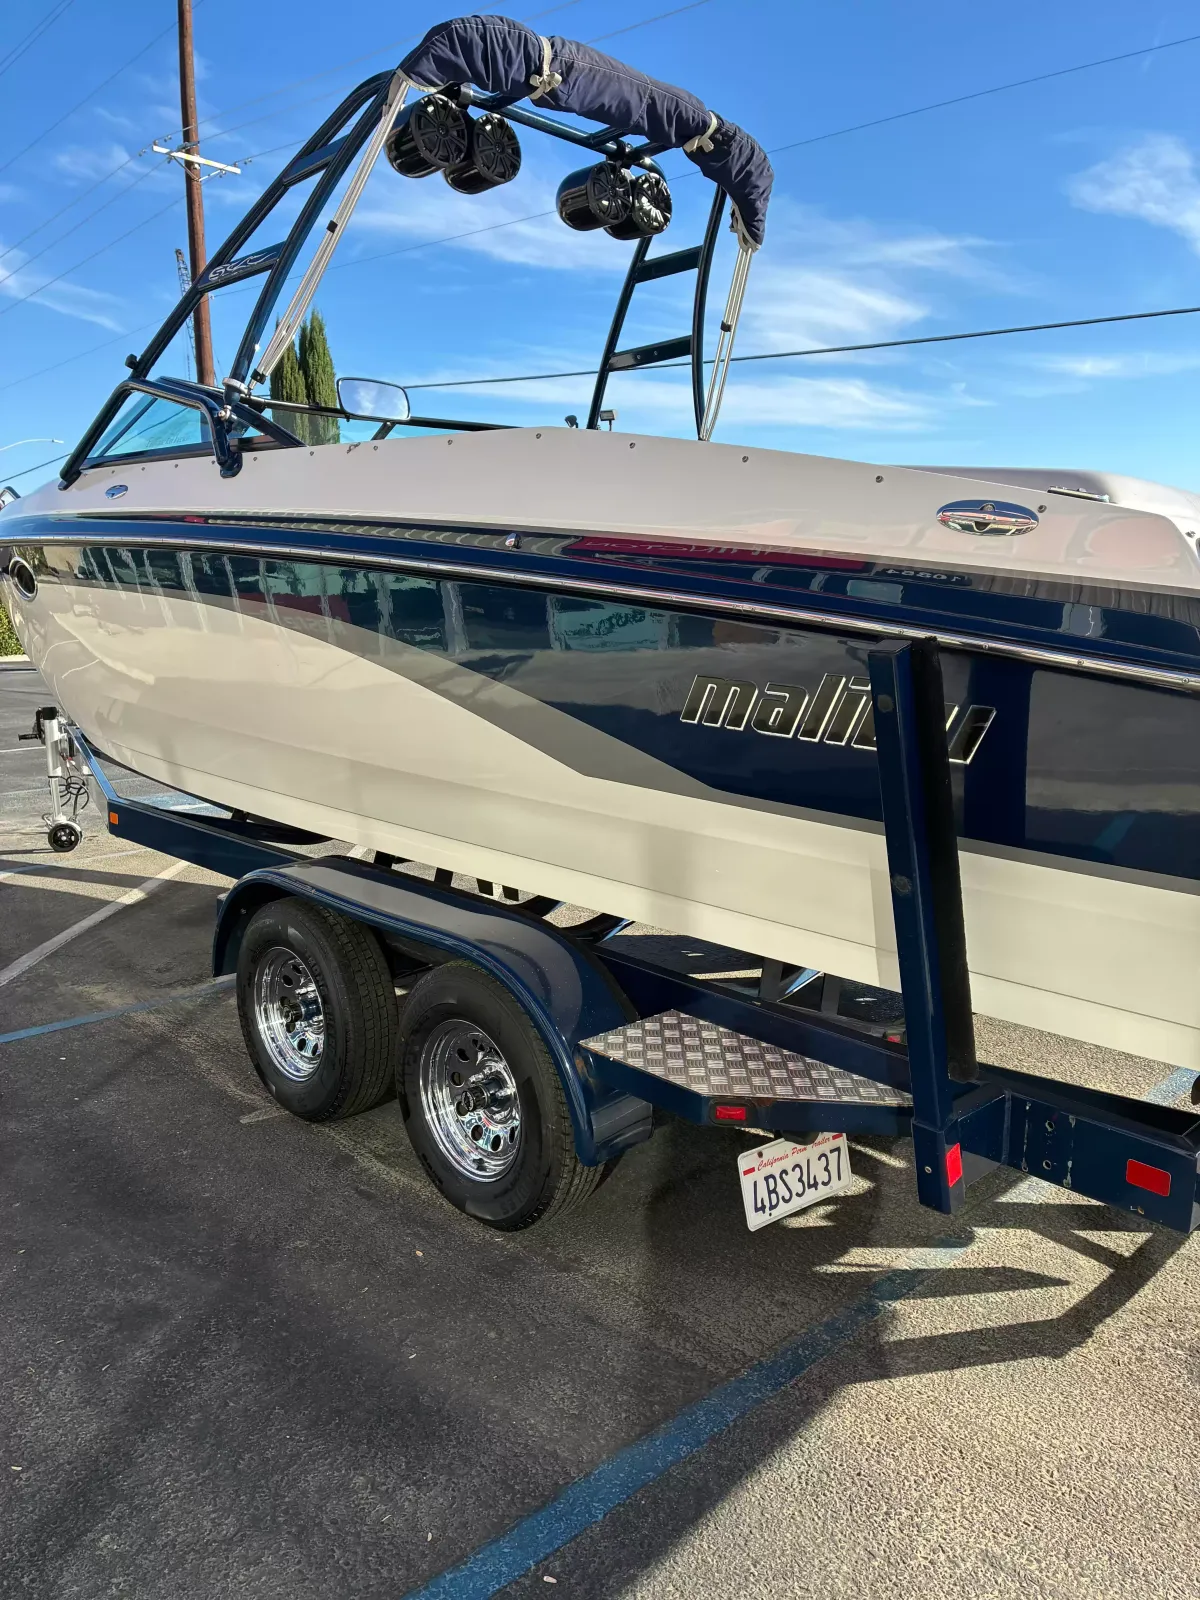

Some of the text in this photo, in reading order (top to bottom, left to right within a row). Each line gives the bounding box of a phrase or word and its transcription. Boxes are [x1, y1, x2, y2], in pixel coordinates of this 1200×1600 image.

[753, 1146, 842, 1214] 4BS3437
[757, 1153, 789, 1171] California
[791, 1146, 808, 1156] Perm
